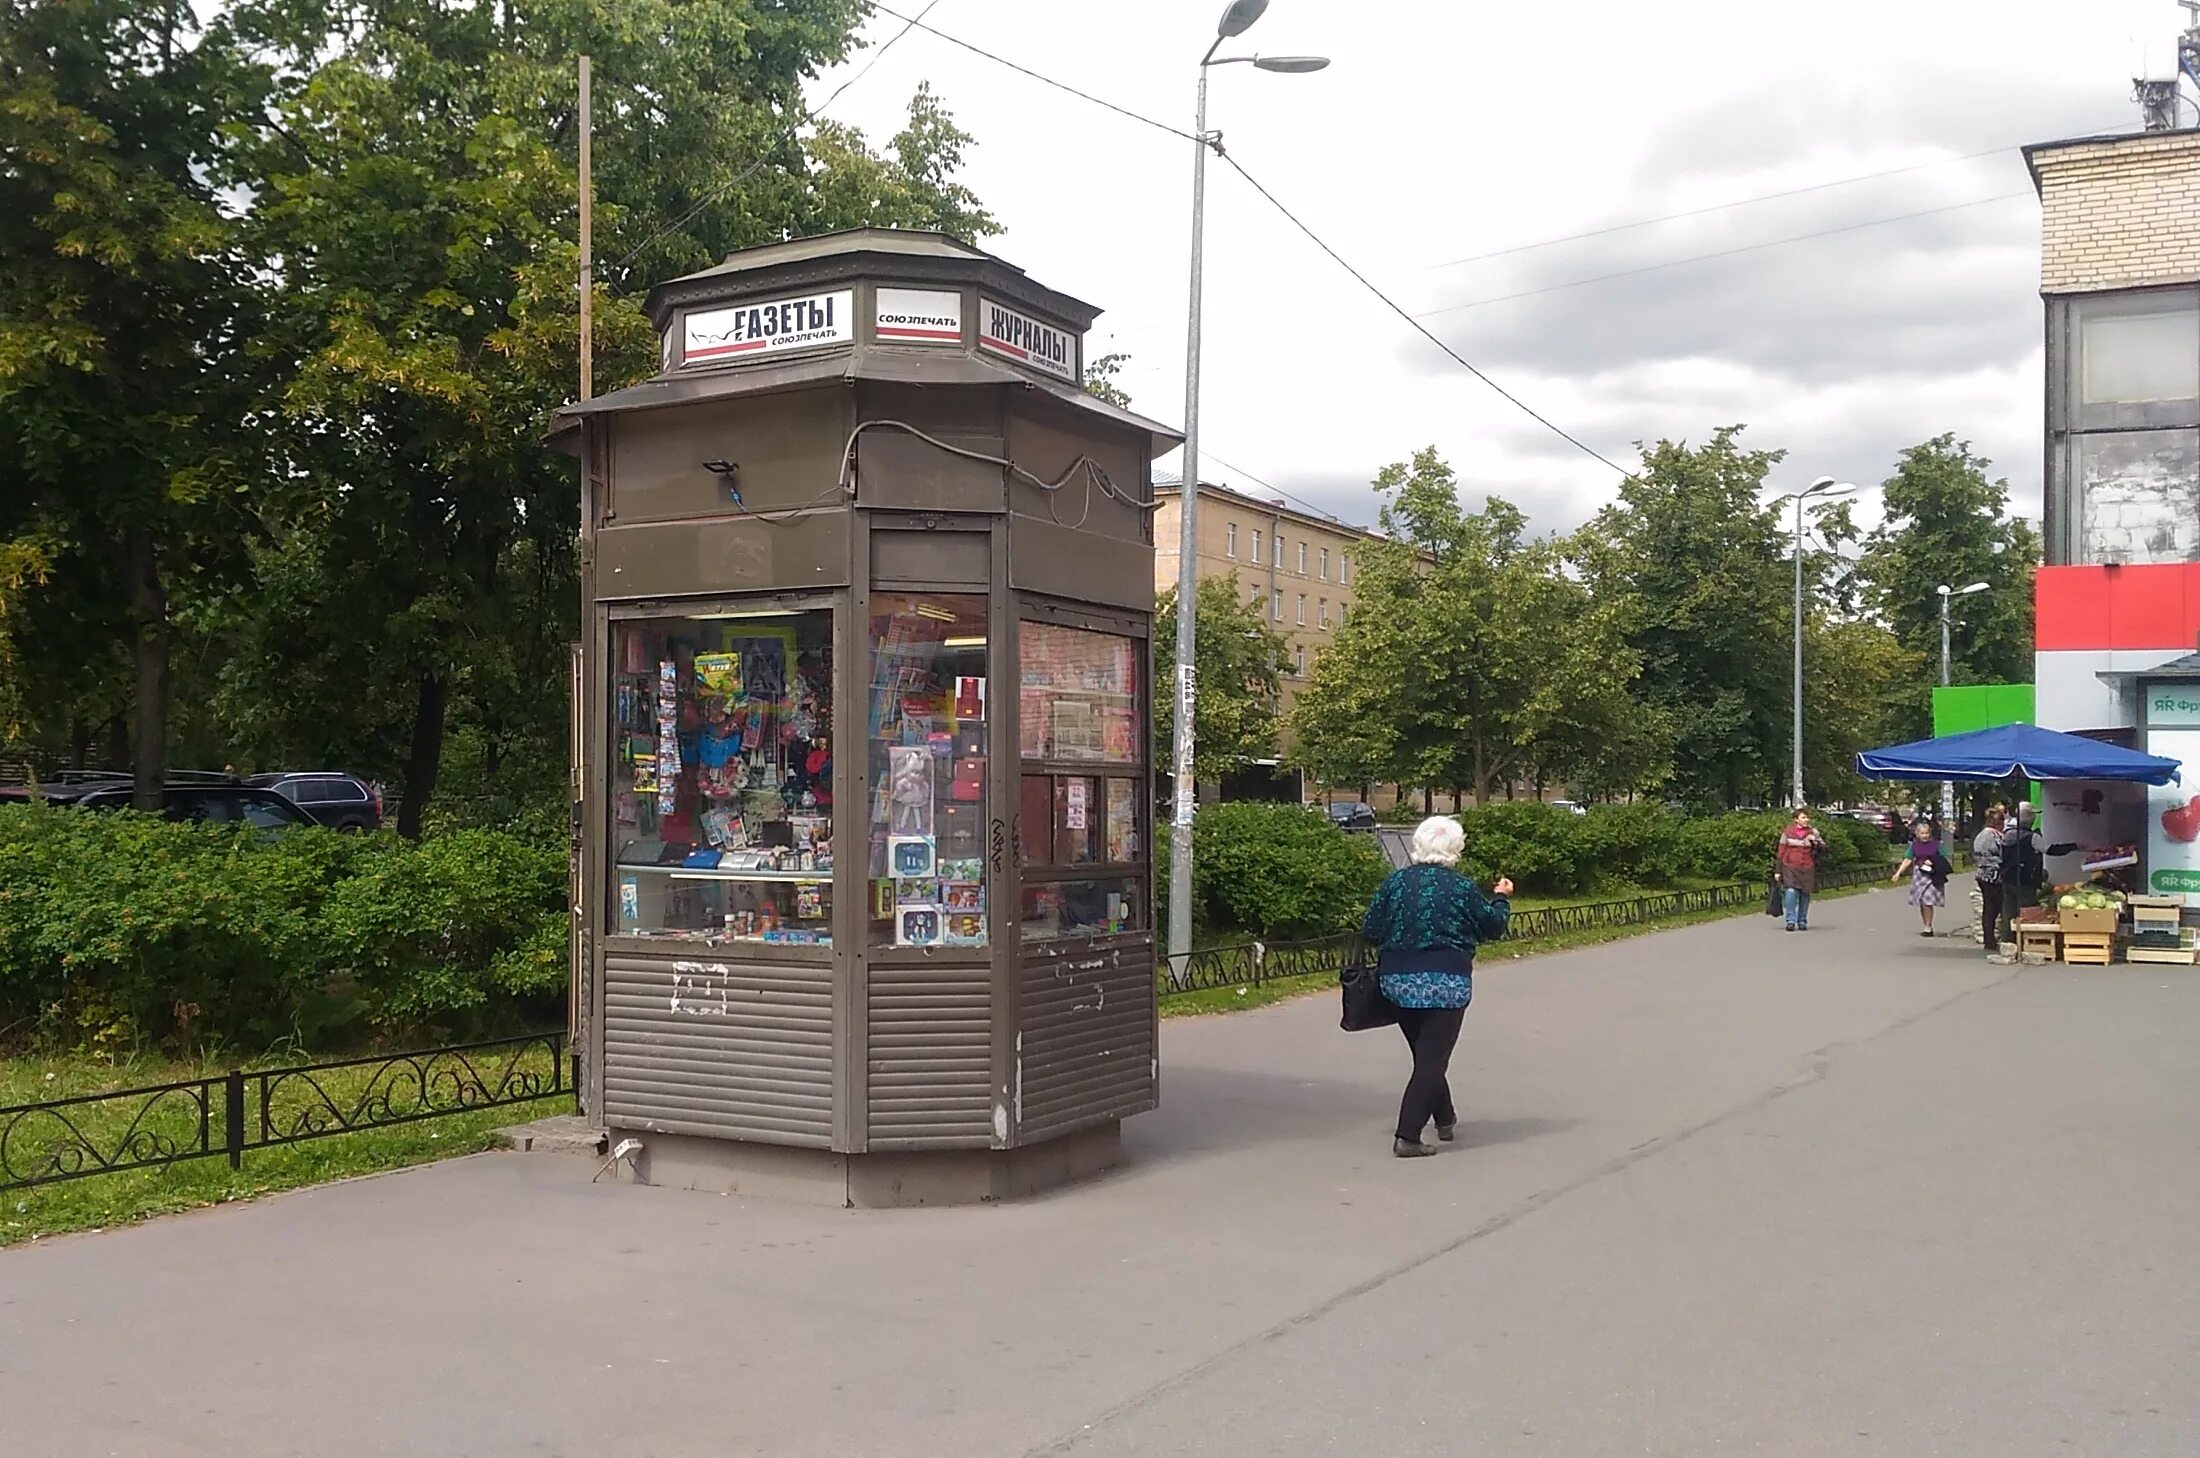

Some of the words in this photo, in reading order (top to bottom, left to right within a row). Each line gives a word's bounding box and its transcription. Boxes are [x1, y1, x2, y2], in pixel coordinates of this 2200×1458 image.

[734, 297, 834, 342] ГАЗЕТЫ
[879, 314, 957, 327] СОЮЗПЕЧАТЬ
[772, 329, 838, 346] СОЮЗПЕЧАТЬ
[991, 306, 1067, 365] ЖУРНАЛЫ
[1032, 355, 1069, 375] СОЮЗПЕЧАТЬ
[2177, 699, 2200, 714] Фр
